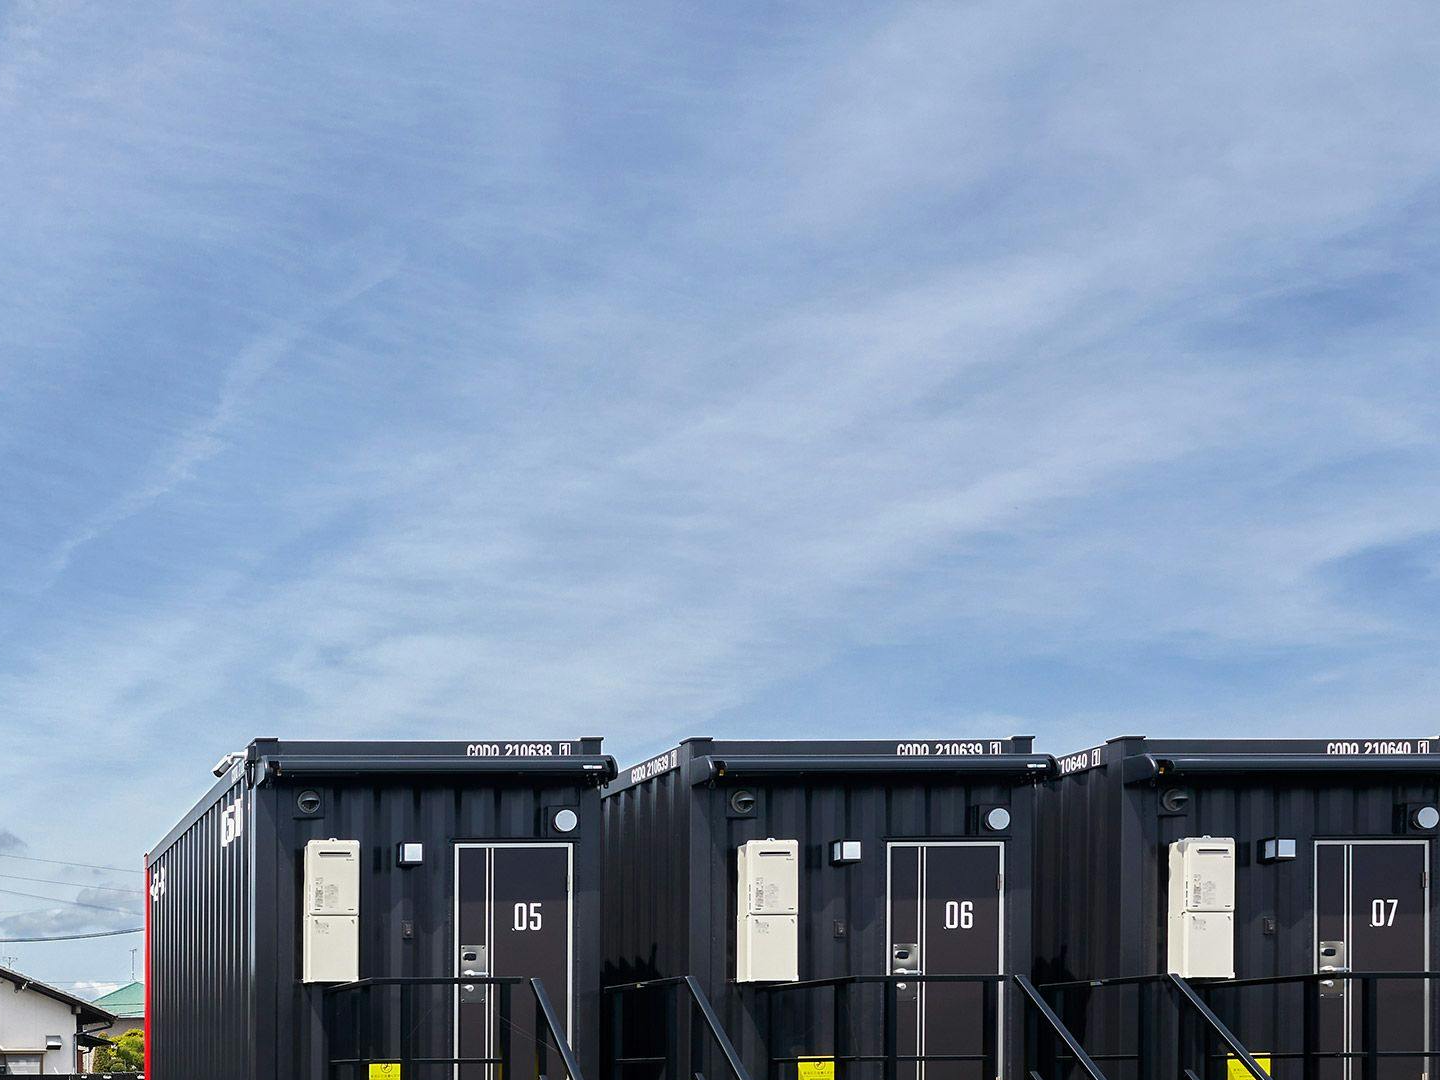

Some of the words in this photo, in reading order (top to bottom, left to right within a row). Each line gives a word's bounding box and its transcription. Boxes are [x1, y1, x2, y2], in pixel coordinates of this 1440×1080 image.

[504, 743, 553, 756] 210638
[935, 742, 983, 756] 210639
[1364, 741, 1412, 755] 210640
[1058, 753, 1088, 774] 10640
[513, 902, 542, 931] 05
[945, 901, 974, 929] 06
[1372, 899, 1399, 927] 07
